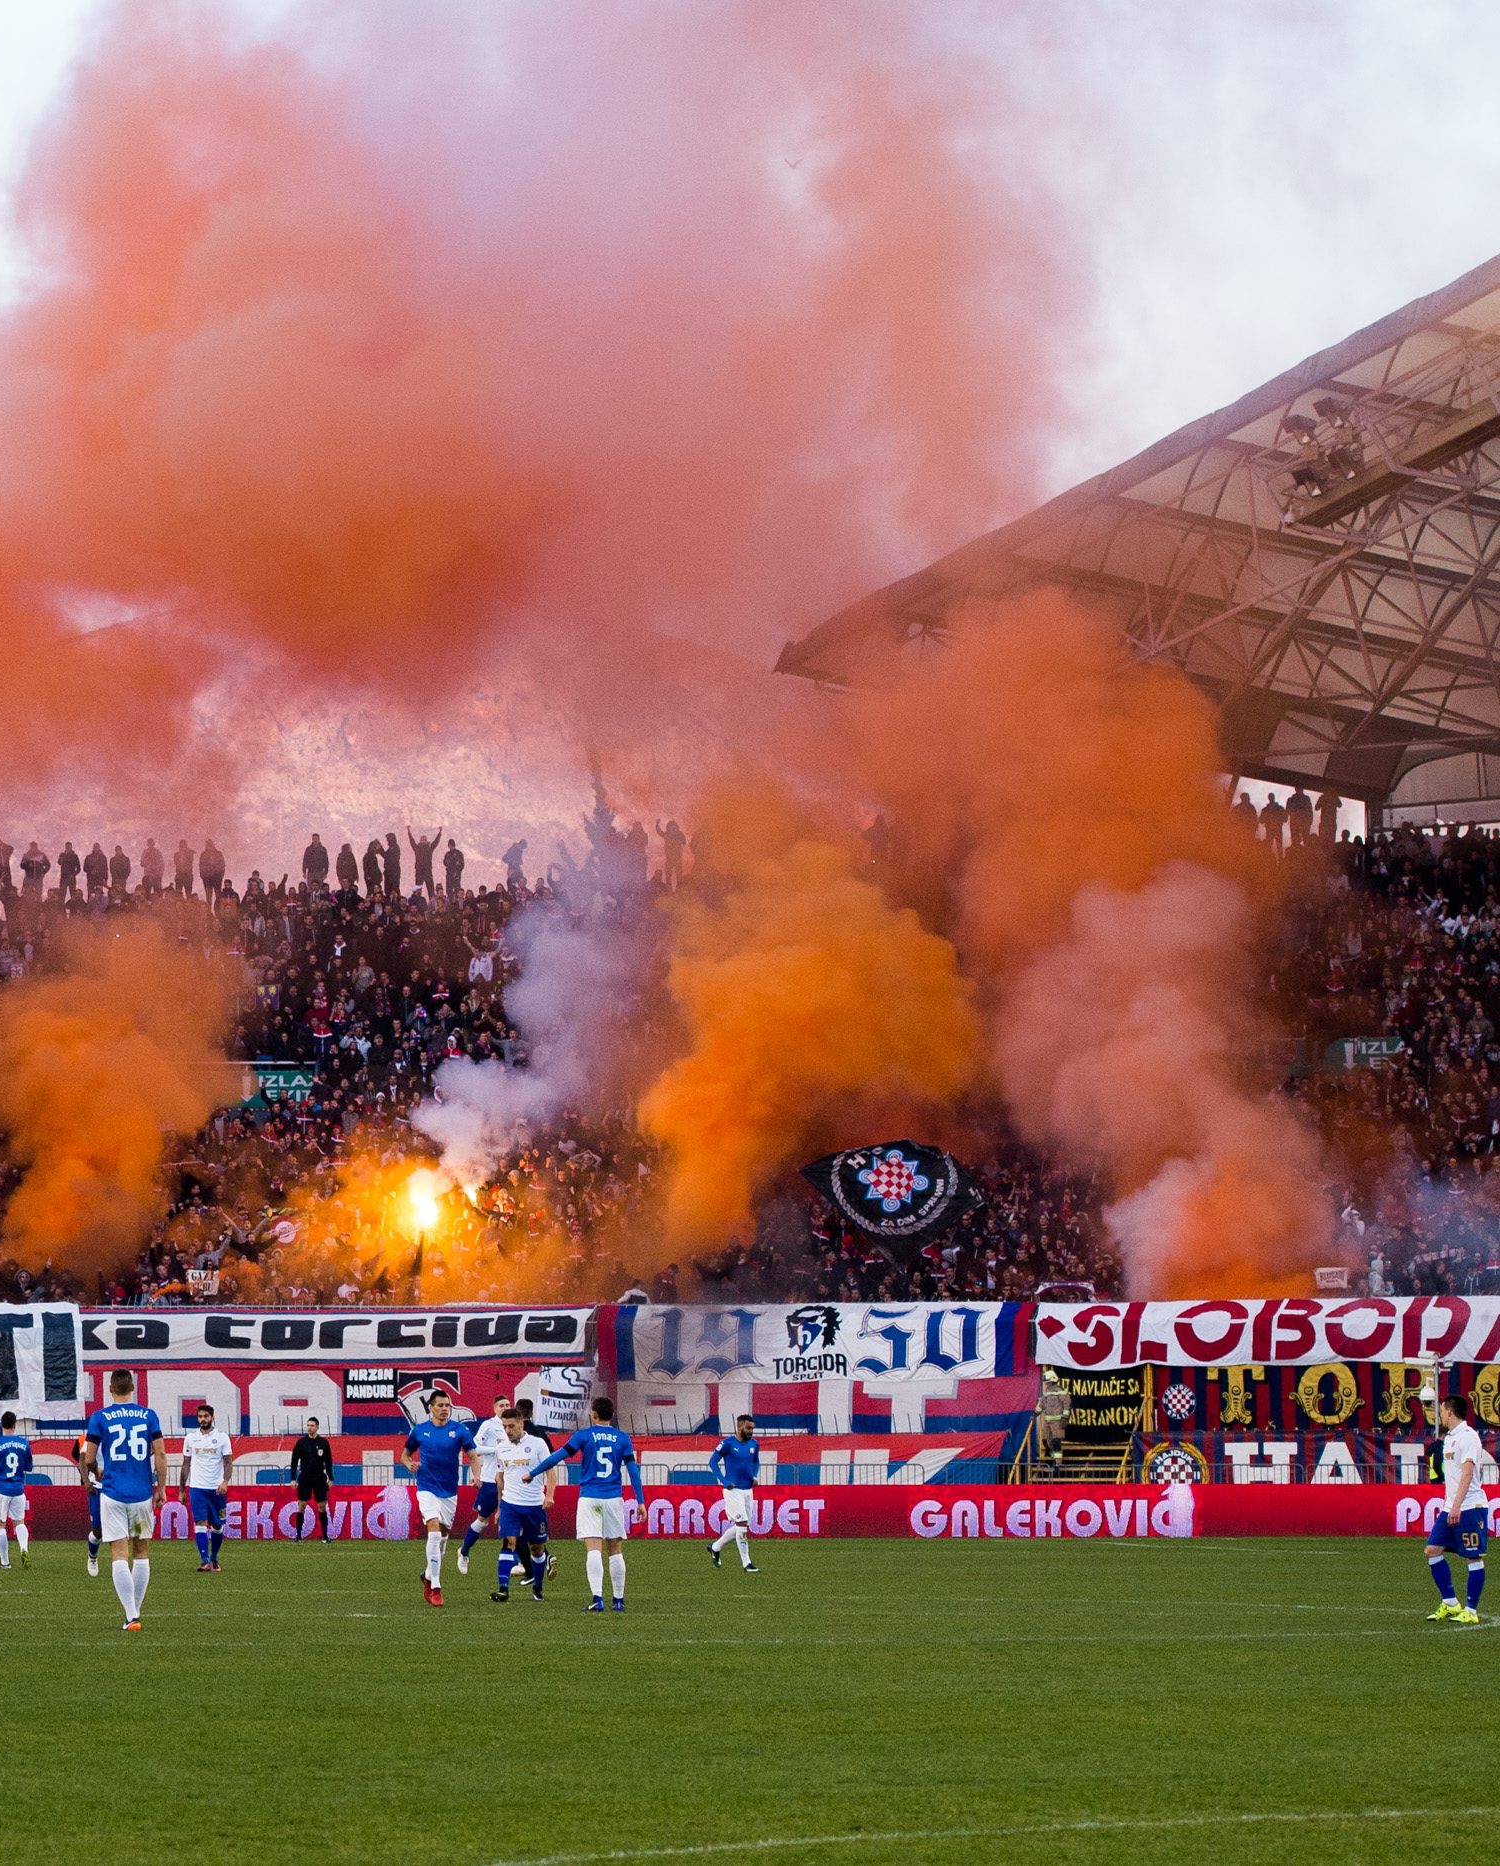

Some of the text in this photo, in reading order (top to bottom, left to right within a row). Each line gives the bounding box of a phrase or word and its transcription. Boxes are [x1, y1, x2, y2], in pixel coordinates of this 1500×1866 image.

[647, 1306, 987, 1381] 19 50
[772, 1352, 848, 1380] TORCIDA
[792, 1371, 825, 1382] SPLIT
[345, 1384, 395, 1399] PANDURE
[1164, 1384, 1194, 1397] HAJDUK
[102, 1407, 149, 1421] benković
[1069, 1405, 1139, 1426] ABRANOM
[1166, 1409, 1190, 1420] SPLIT
[108, 1423, 148, 1462] 26
[5, 1452, 19, 1478] 9
[596, 1446, 613, 1478] 5
[1154, 1449, 1195, 1465] HAJDUK
[152, 1498, 408, 1539] AEKOVIĆ
[1461, 1532, 1480, 1547] 50
